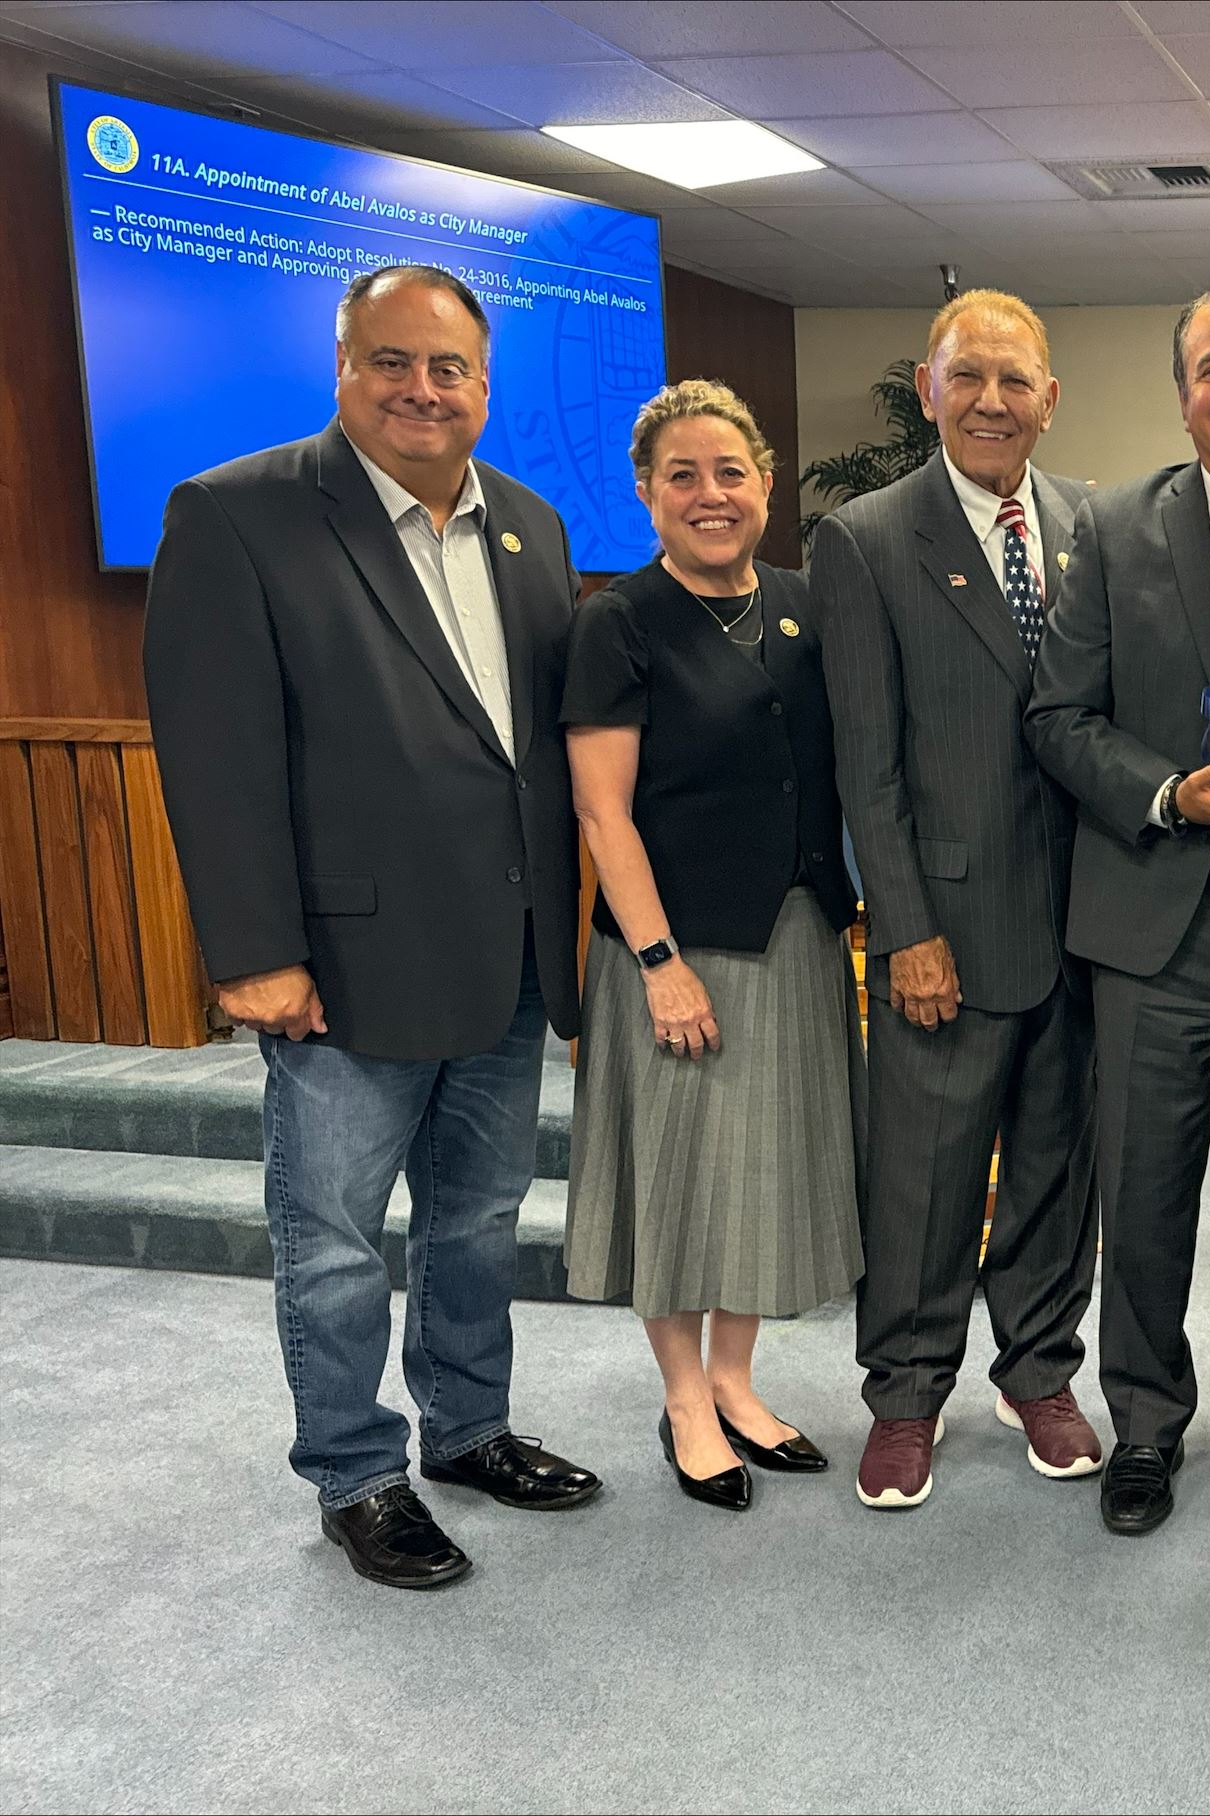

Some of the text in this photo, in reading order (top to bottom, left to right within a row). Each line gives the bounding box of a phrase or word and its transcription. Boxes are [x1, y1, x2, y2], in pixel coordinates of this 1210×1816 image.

[152, 154, 528, 245] 11A. Appointment of Abel Avalos as City Manager
[93, 226, 113, 242] as
[118, 227, 152, 253] City
[157, 233, 233, 263] Manager
[237, 250, 268, 267] and
[271, 253, 350, 285] Approving
[473, 289, 534, 310] greement
[115, 205, 246, 243] Recommended
[250, 230, 303, 254] Action:
[307, 240, 352, 263] Adopt
[458, 266, 513, 291] 24-3016,
[515, 277, 581, 304] Appointing
[583, 288, 608, 306] Abel
[610, 294, 646, 312] Avalos
